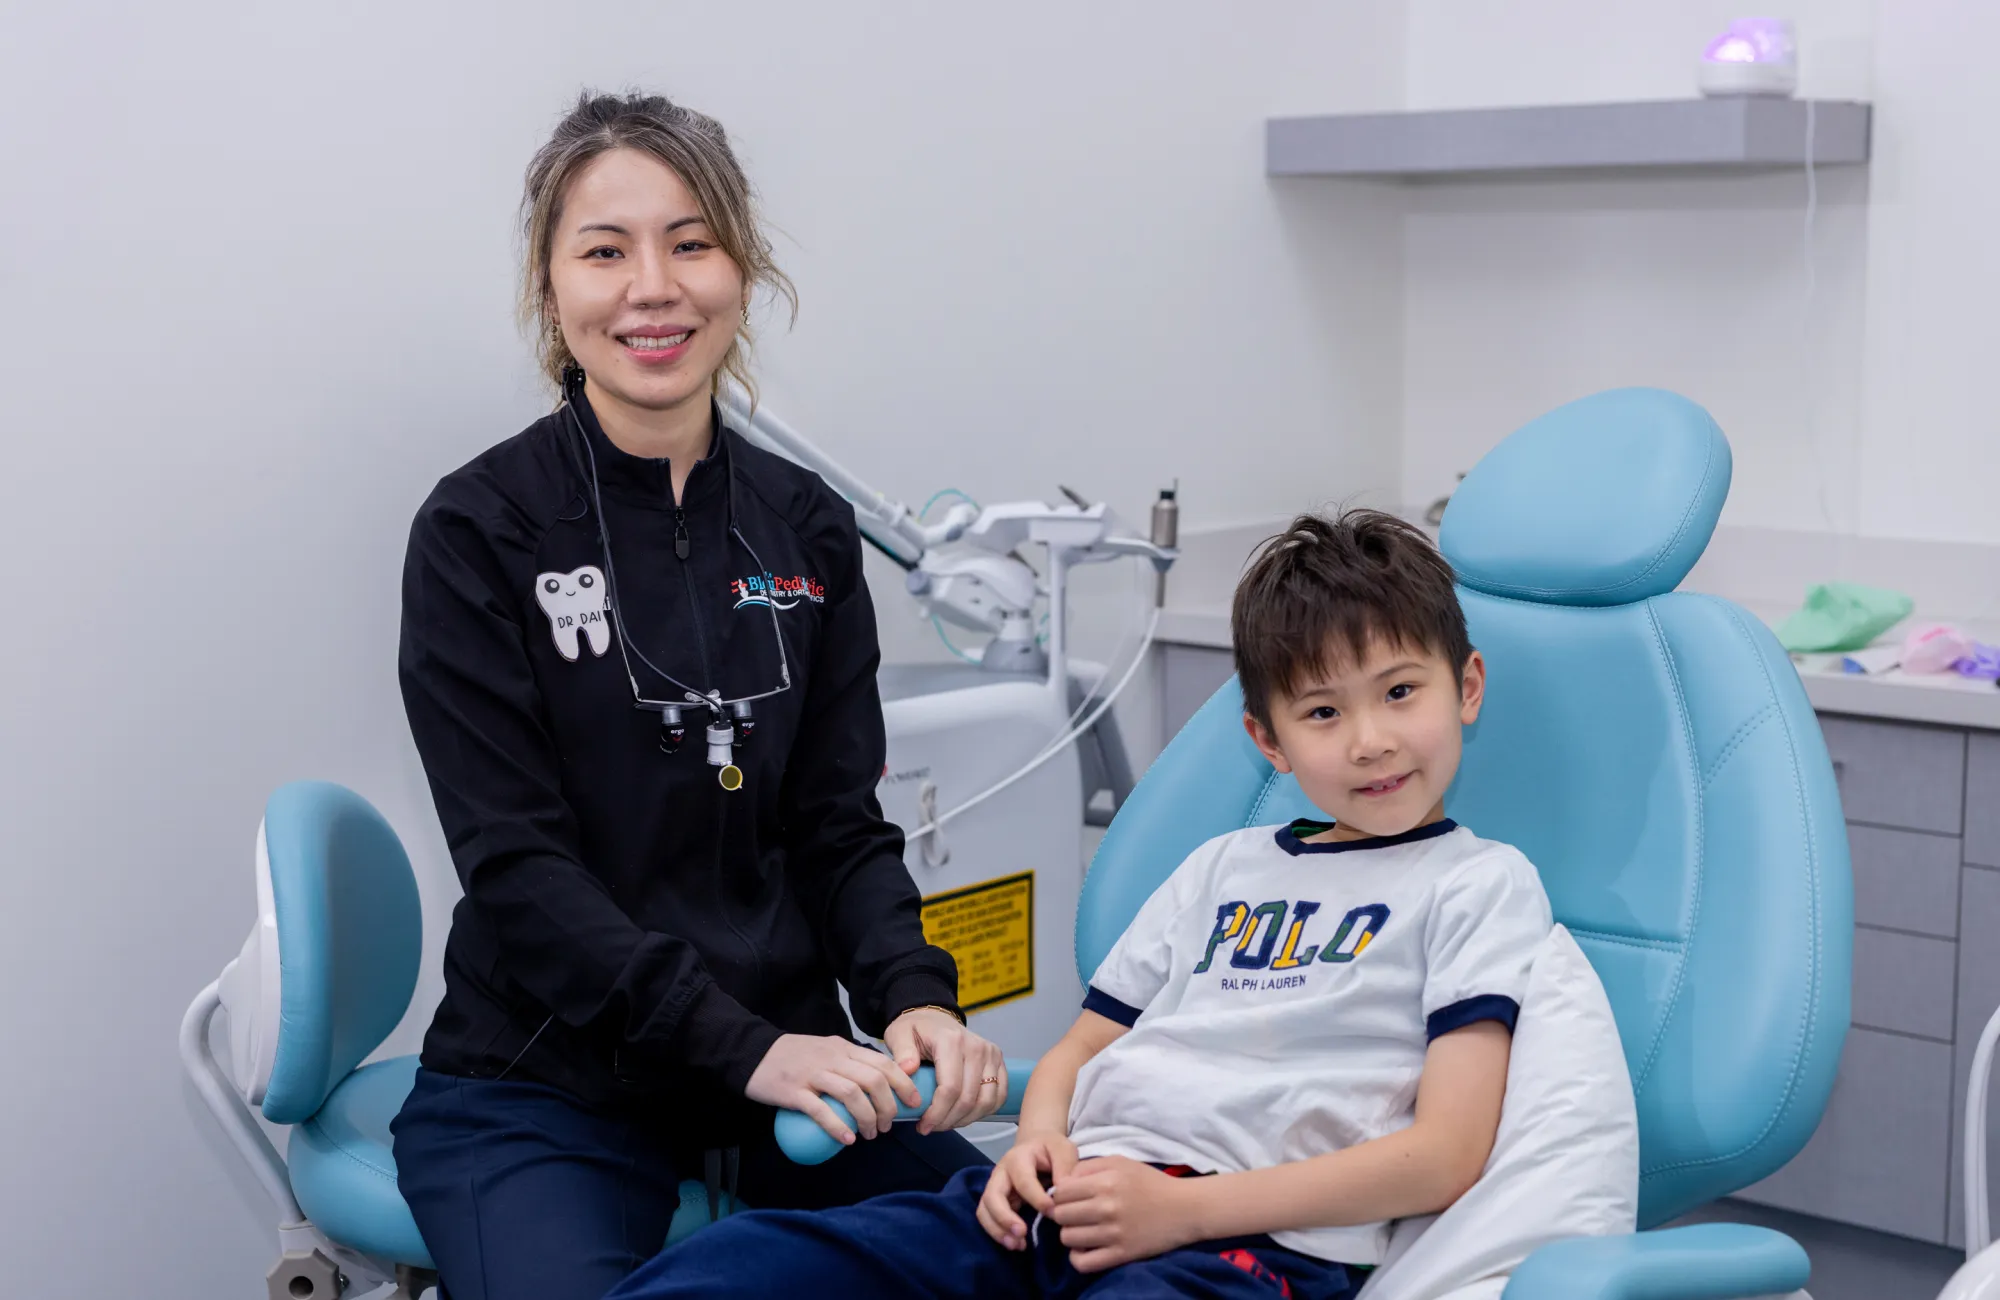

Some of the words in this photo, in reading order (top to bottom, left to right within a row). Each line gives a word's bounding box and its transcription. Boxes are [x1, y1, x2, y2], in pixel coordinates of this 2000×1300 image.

[557, 615, 574, 629] DR
[580, 610, 602, 625] DAI
[670, 728, 685, 736] ergo
[741, 721, 755, 729] ergo
[1193, 899, 1391, 974] POLO
[1221, 978, 1258, 991] RALPH
[1261, 974, 1306, 991] LAUREN
